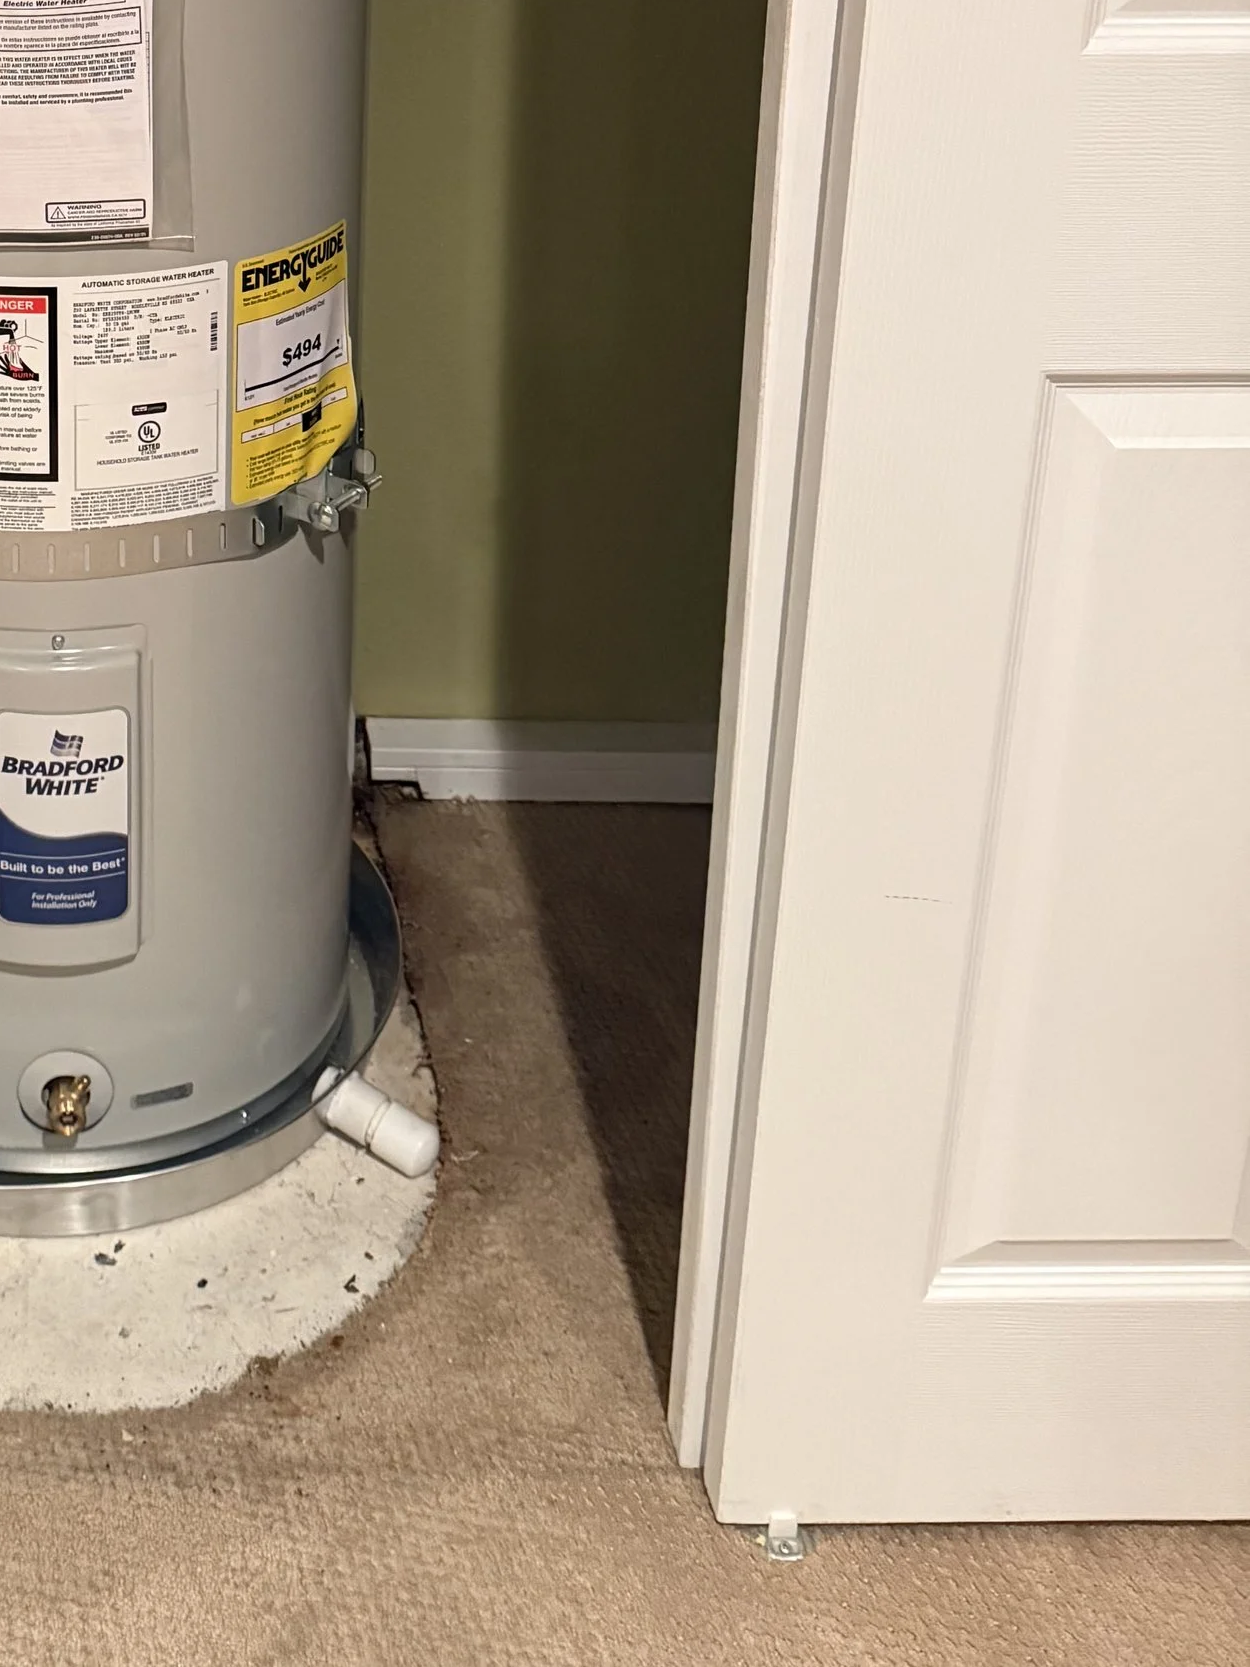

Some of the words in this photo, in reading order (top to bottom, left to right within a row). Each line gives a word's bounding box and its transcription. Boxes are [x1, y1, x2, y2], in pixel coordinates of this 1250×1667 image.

[3, 0, 33, 8] Electric
[242, 230, 344, 293] ENERGYGUIDE
[81, 279, 125, 289] AUTOMATIC
[126, 276, 161, 286] STORAGE
[162, 272, 187, 282] WATER
[187, 268, 215, 279] HEATER
[2, 344, 21, 352] HOT
[282, 333, 322, 367] $494
[138, 443, 161, 452] LISTED
[96, 457, 127, 466] HOUSEHOLD
[127, 455, 150, 464] STORAGE
[180, 448, 199, 456] HEATER
[1, 754, 124, 777] BRADFORD
[25, 777, 98, 796] WHITE
[0, 859, 27, 874] Built
[31, 861, 44, 874] to
[47, 861, 65, 875] be
[68, 861, 89, 875] the
[31, 891, 45, 901] For
[46, 890, 95, 902] Professional
[31, 899, 77, 909] Installation
[78, 898, 97, 910] Only
